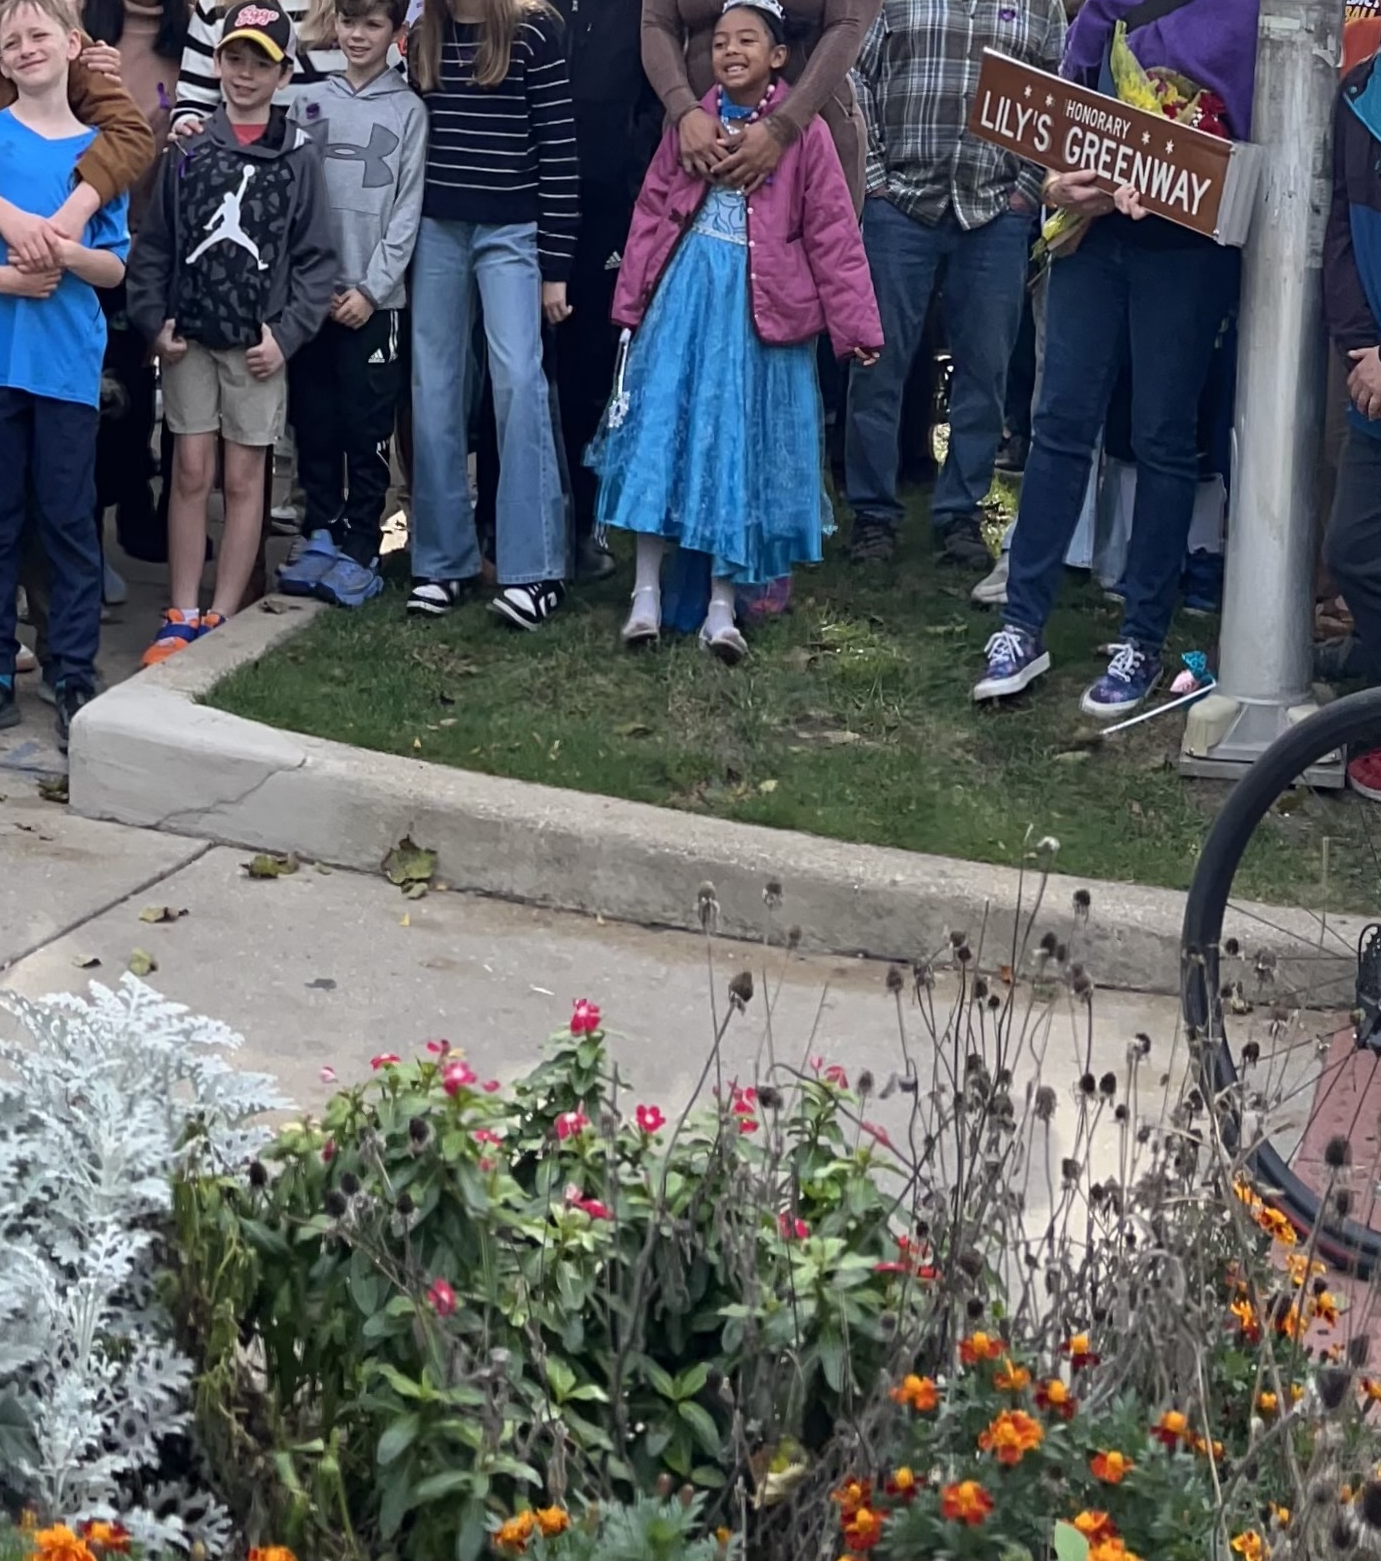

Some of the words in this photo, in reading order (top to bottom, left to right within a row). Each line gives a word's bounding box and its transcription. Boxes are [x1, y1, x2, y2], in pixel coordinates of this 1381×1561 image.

[980, 90, 1052, 152] LILY'S
[1063, 126, 1212, 216] GREENWAY
[1066, 99, 1131, 139] HONORARY
